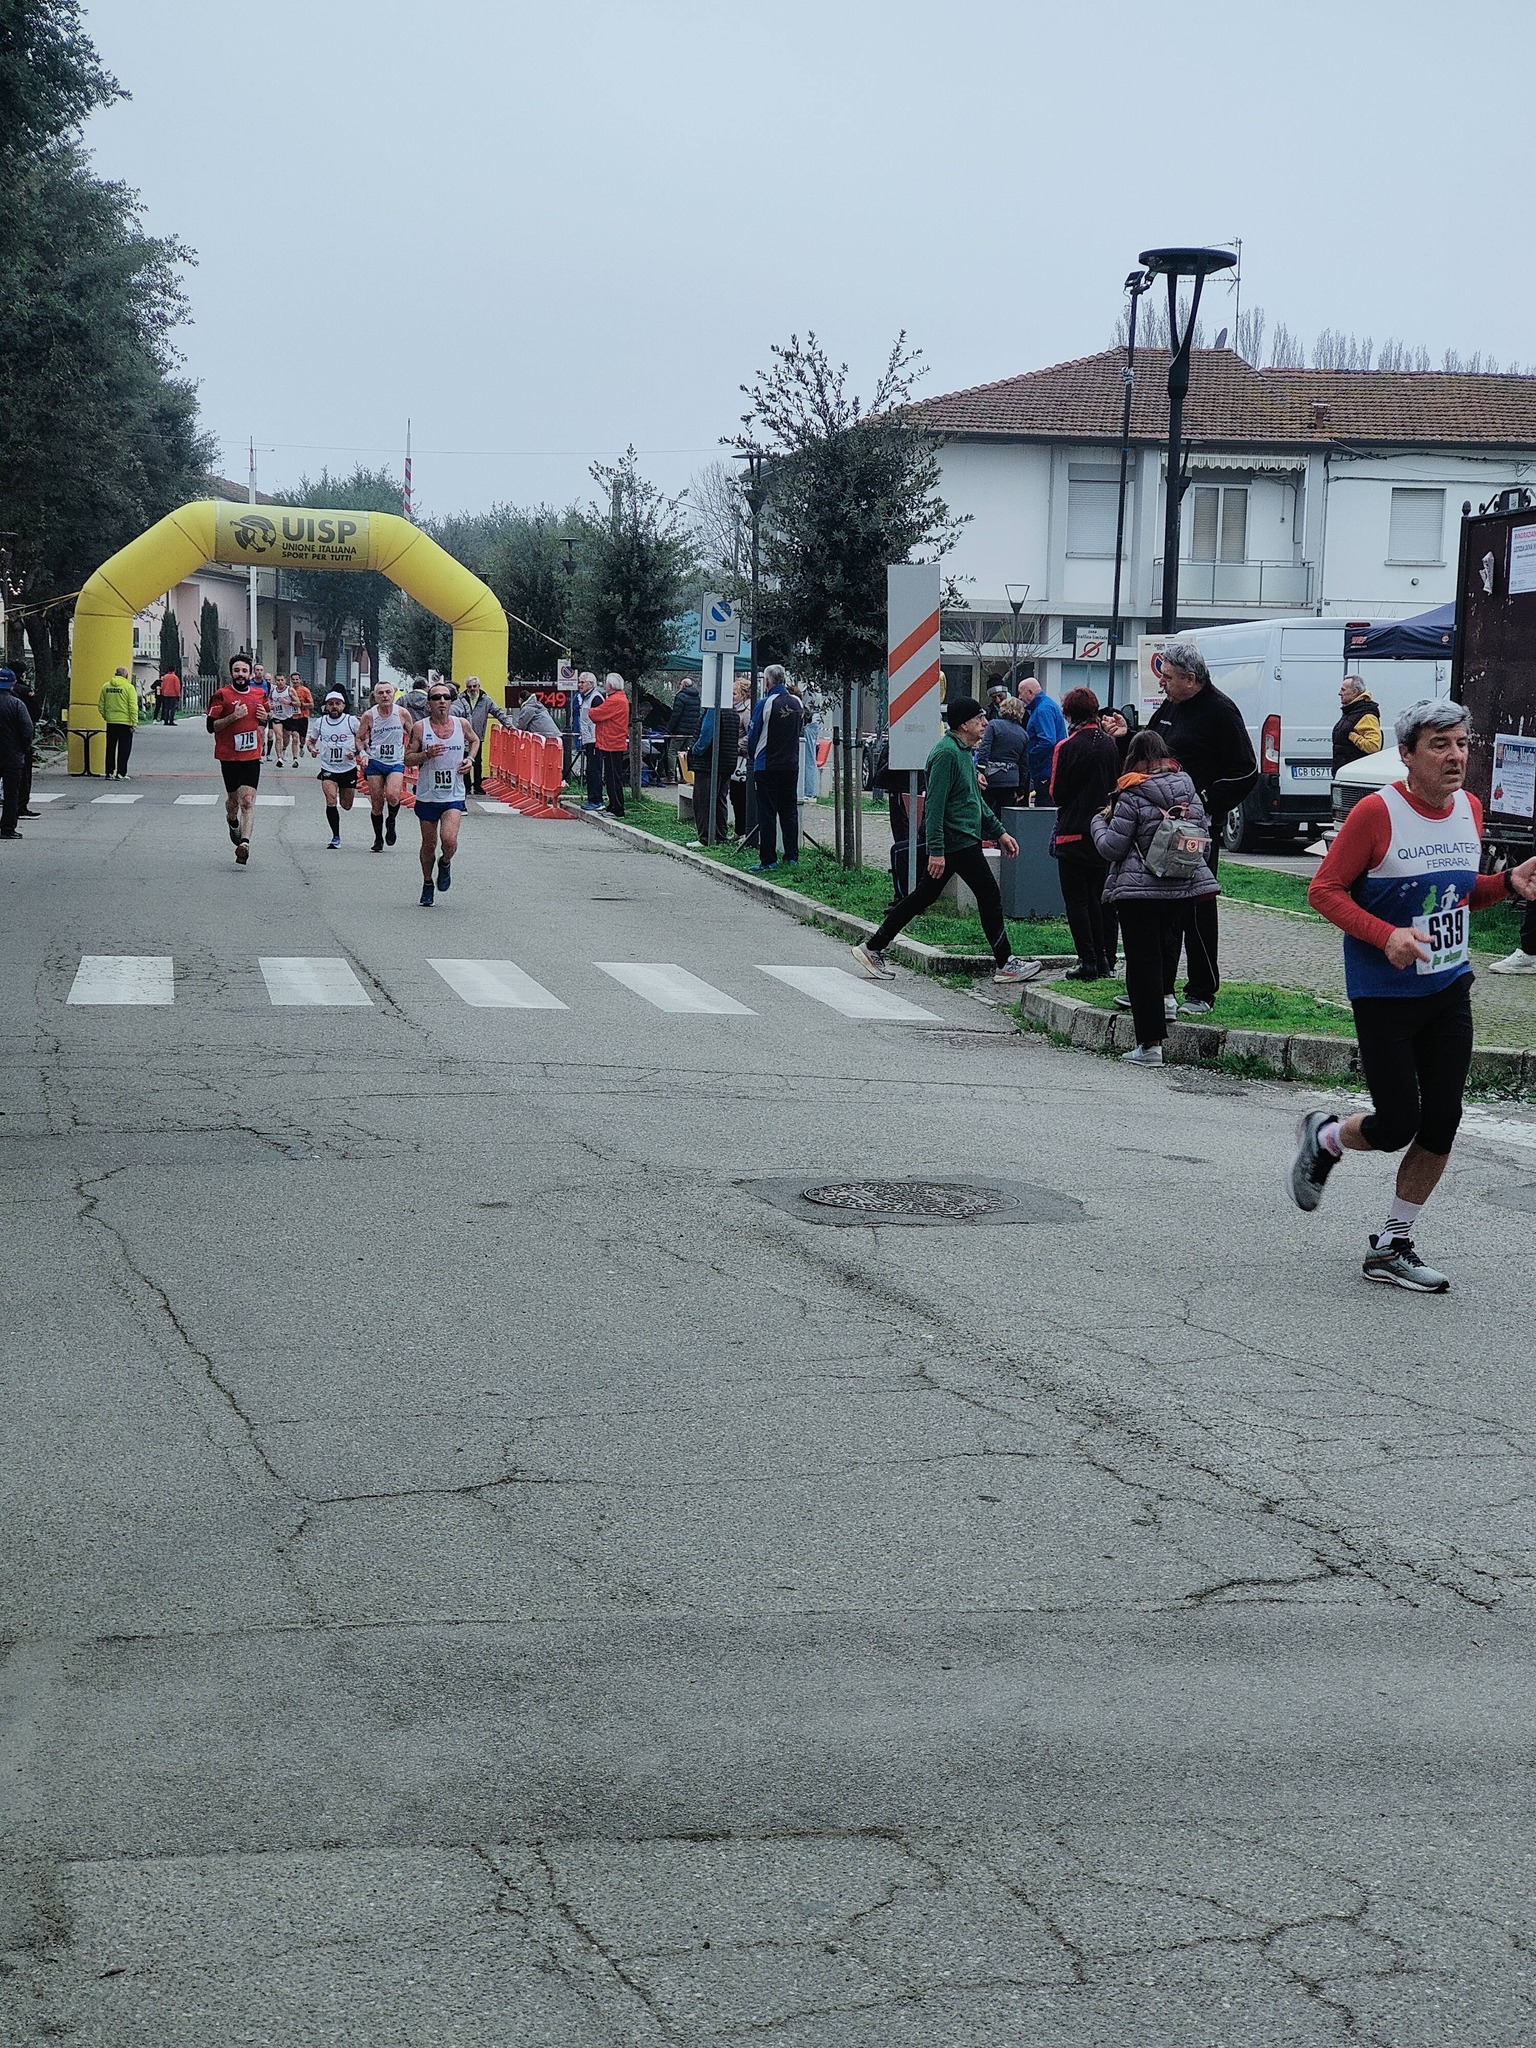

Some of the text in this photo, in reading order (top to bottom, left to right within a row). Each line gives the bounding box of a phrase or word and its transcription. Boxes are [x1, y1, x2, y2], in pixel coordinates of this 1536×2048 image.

[282, 517, 357, 544] UISP
[282, 543, 357, 554] UNIONE ITALIANA
[282, 551, 308, 560] SPORT
[706, 630, 715, 640] P
[240, 732, 254, 746] 776
[330, 748, 343, 758] 707
[380, 744, 394, 755] 633
[434, 770, 452, 784] 613
[1397, 843, 1481, 860] QUADRILATERO
[1426, 857, 1471, 869] FERRARA
